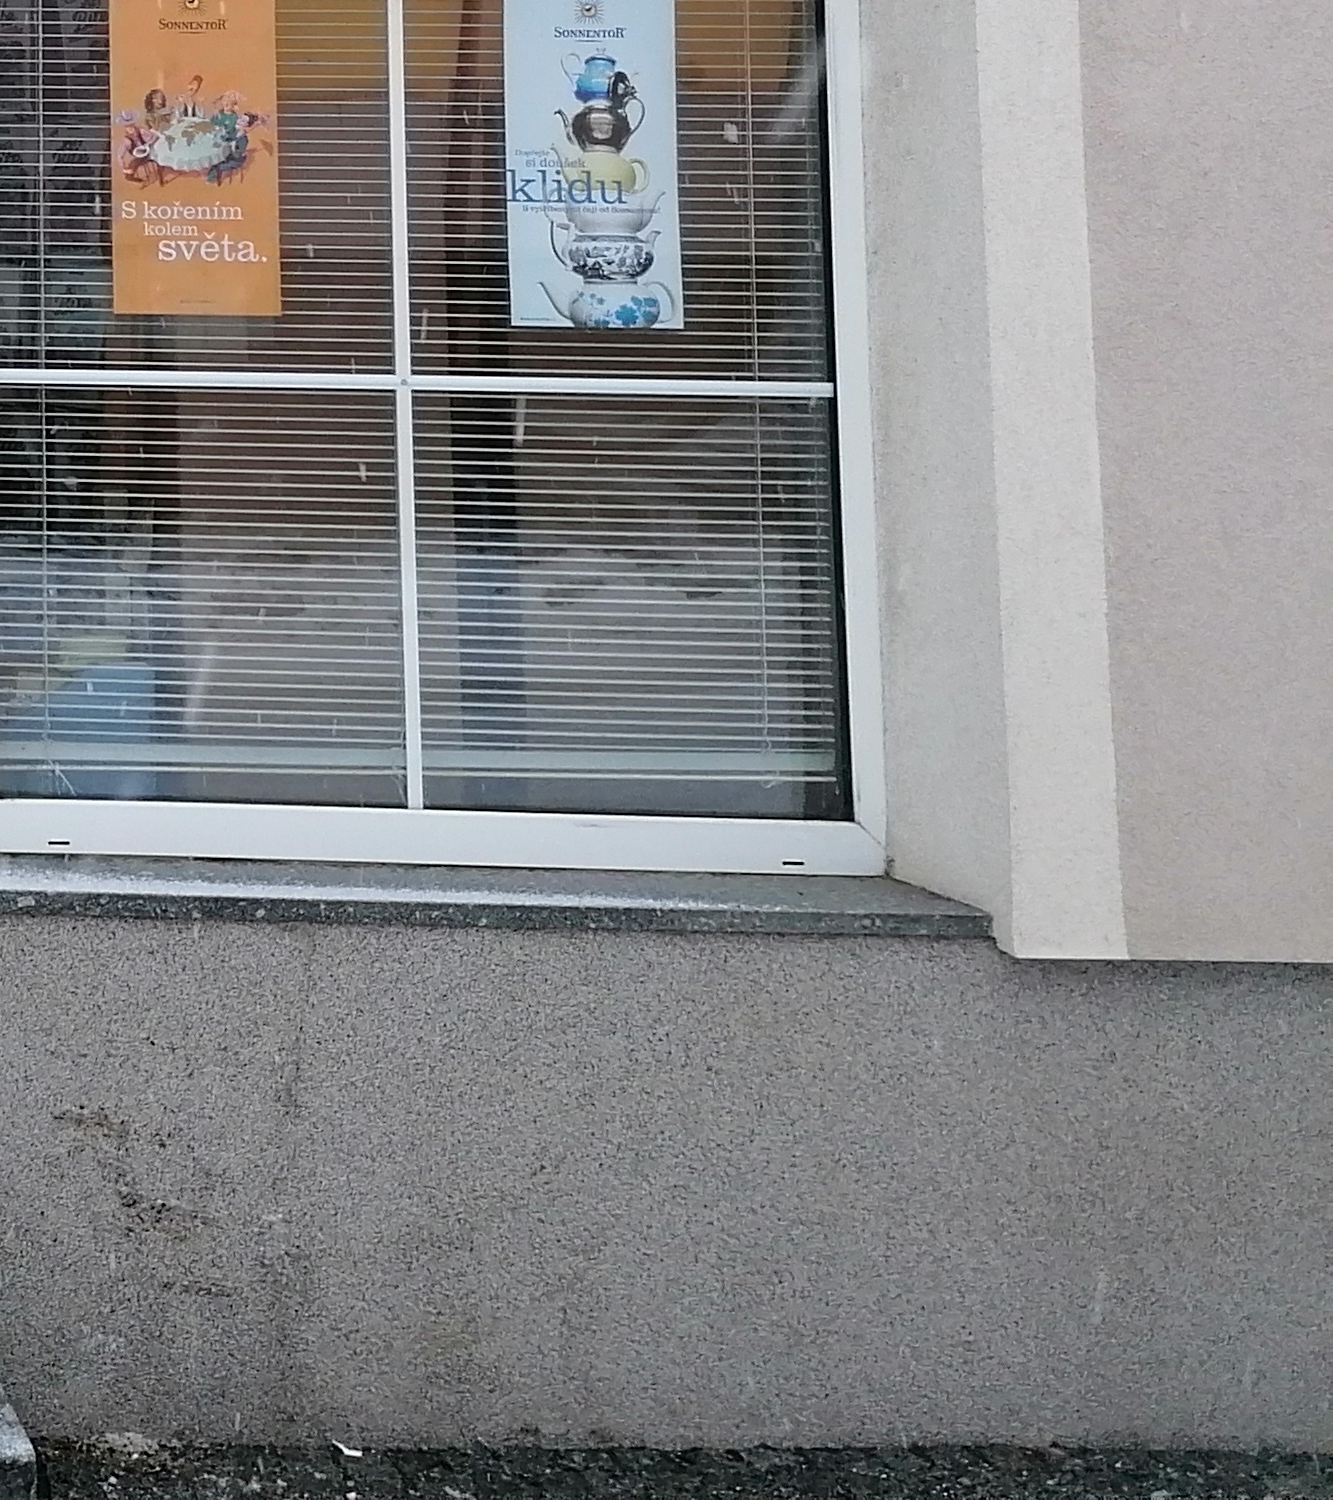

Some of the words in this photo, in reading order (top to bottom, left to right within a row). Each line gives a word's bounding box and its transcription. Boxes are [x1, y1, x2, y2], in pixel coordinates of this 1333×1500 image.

[158, 18, 227, 30] SONNENTOR
[554, 27, 625, 39] SONNENTOR
[525, 157, 536, 167] si
[507, 169, 628, 204] klidu
[121, 202, 136, 219] S
[143, 201, 244, 220] kořením
[143, 222, 198, 236] kolem
[158, 232, 268, 263] světa.
